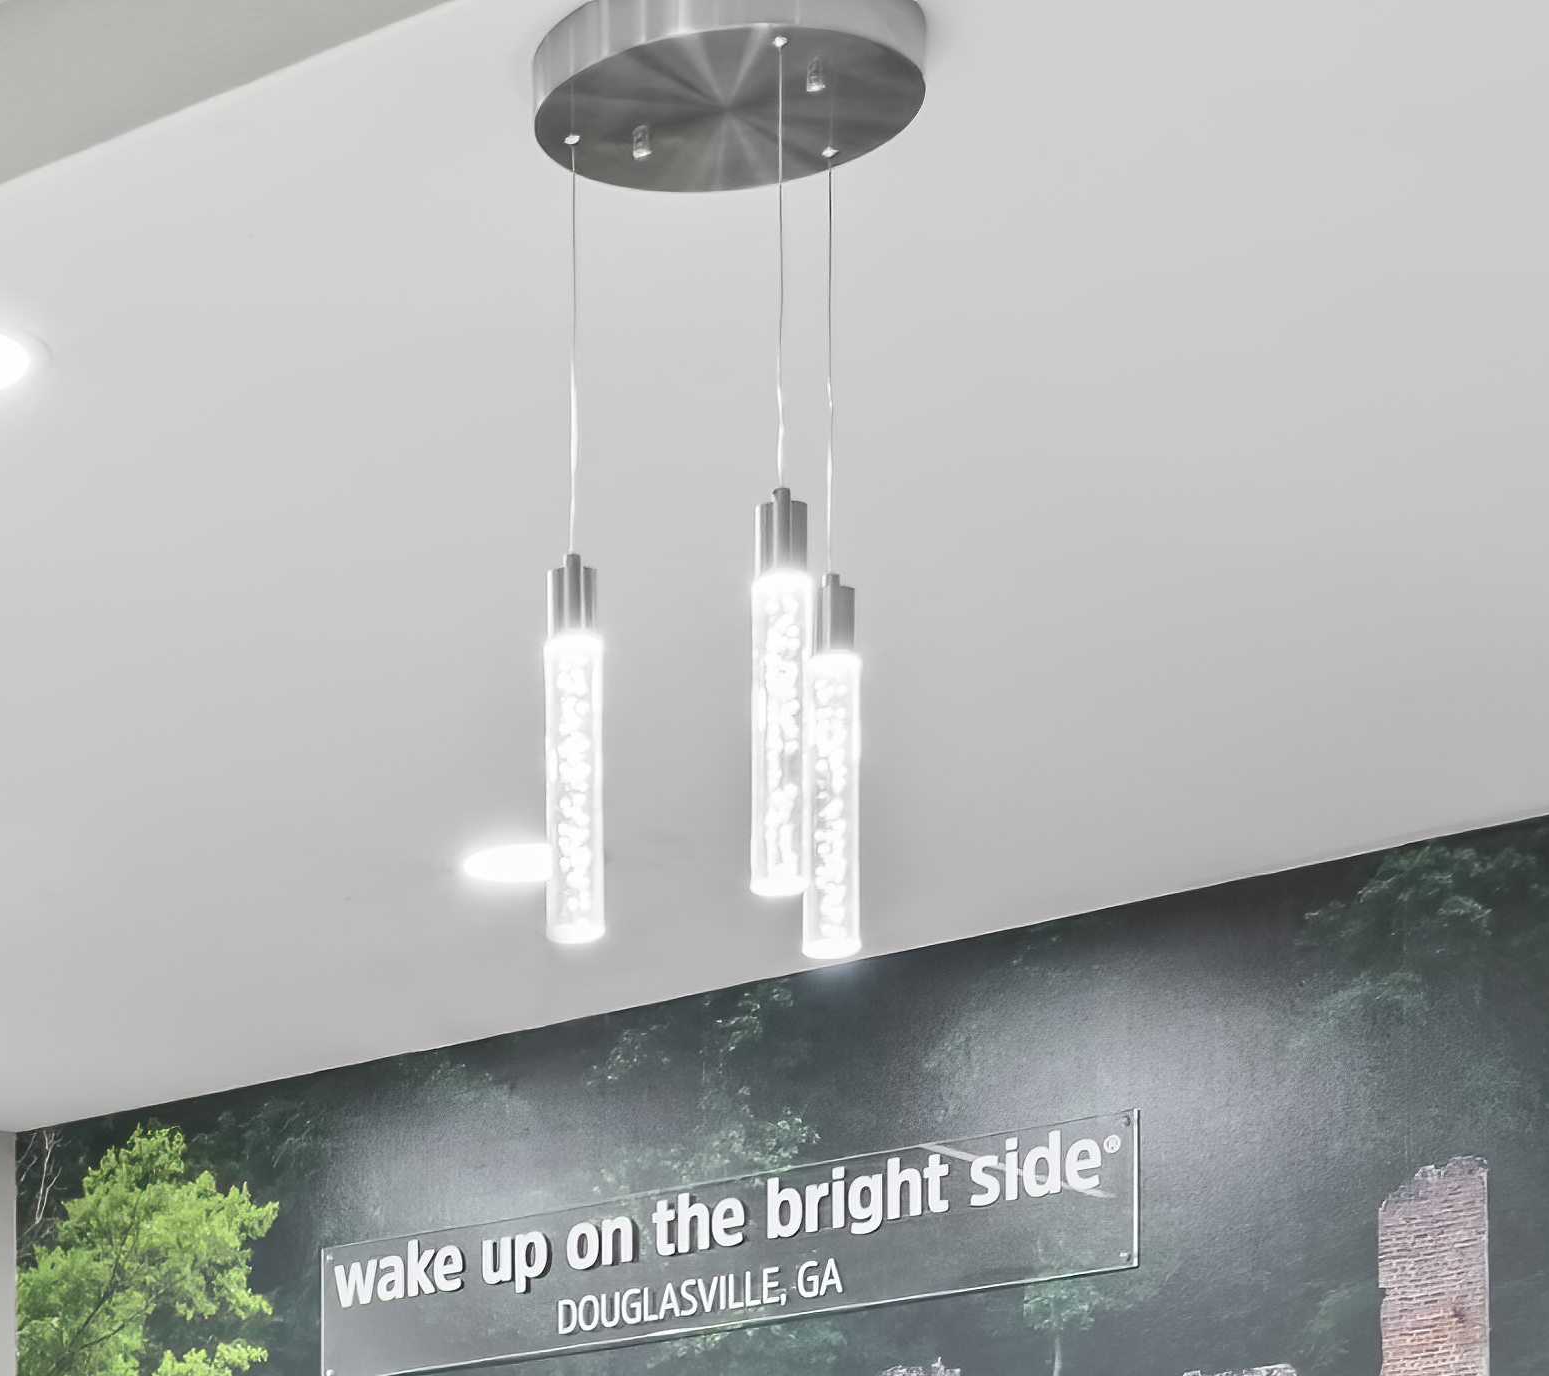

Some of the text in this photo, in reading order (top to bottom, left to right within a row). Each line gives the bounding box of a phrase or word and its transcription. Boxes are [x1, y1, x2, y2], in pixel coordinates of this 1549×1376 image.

[334, 1238, 464, 1309] wake
[481, 1230, 551, 1294] up
[566, 1215, 635, 1270] on
[652, 1193, 746, 1257] the
[767, 1154, 949, 1236] bright
[557, 1257, 843, 1335] DOUGLASVILLE, GA
